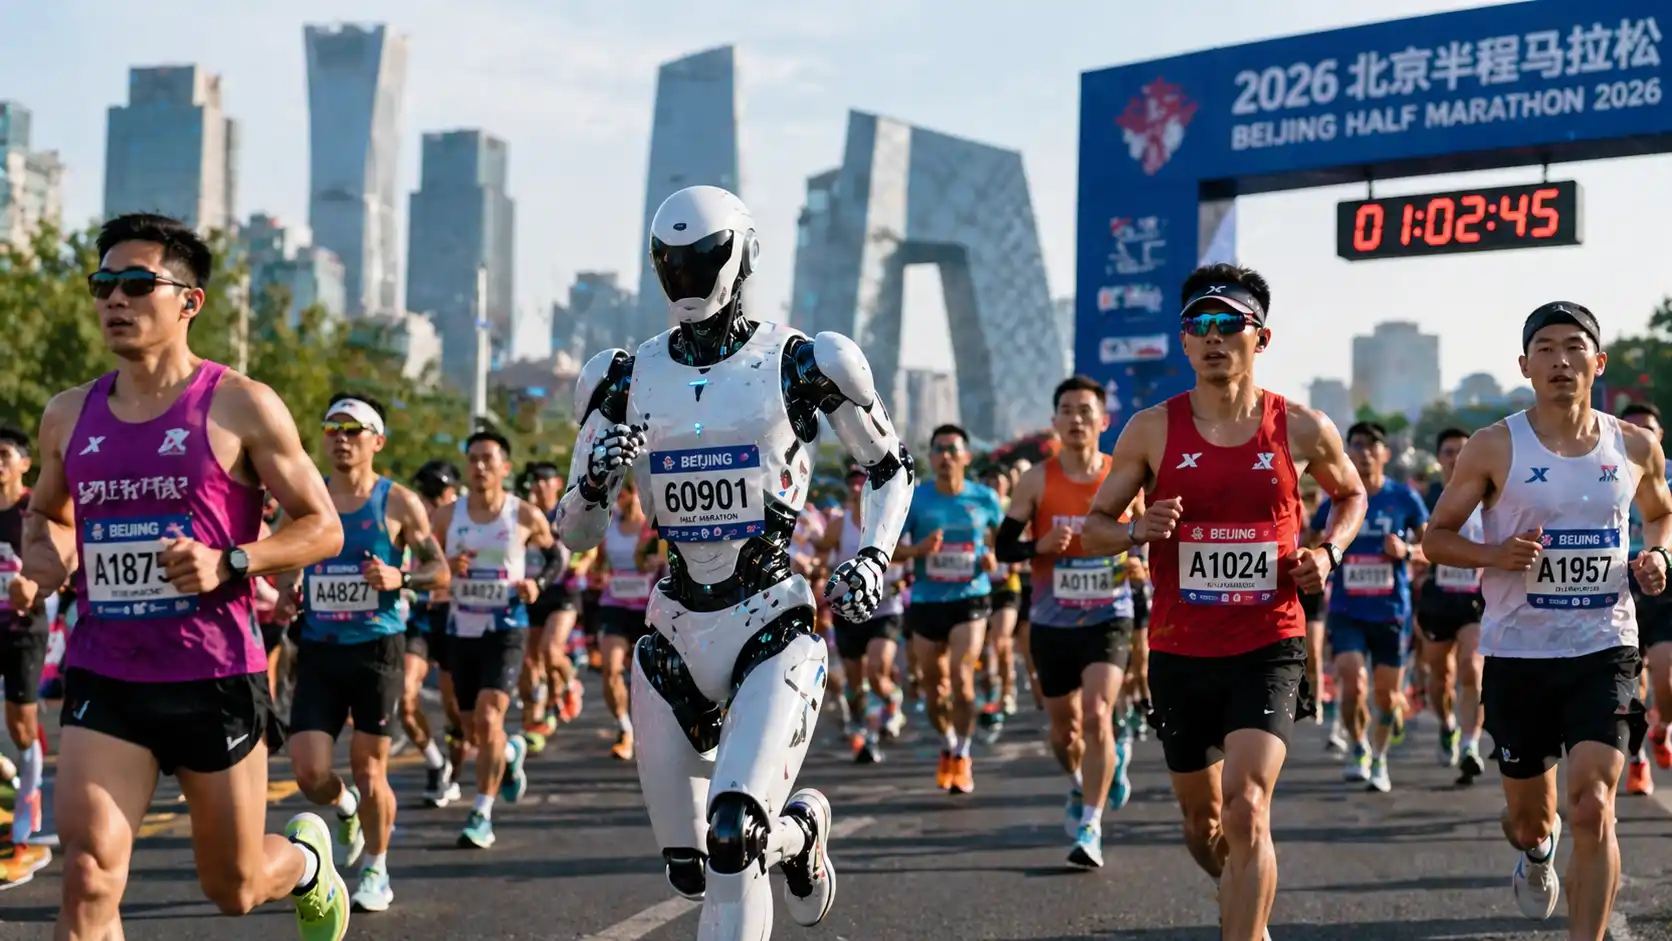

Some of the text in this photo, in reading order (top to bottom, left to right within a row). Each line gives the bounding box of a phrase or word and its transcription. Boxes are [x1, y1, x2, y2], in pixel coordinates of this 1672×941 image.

[1232, 16, 1662, 116] 2026 北京半程马拉松
[1231, 77, 1662, 150] BEIJING HALF MARATHON 2026
[681, 453, 733, 469] BEIJING
[664, 478, 748, 513] 60901
[109, 522, 160, 538] BEIJING
[1210, 528, 1256, 540] BEIJING
[1558, 534, 1601, 546] BEIJING
[1189, 551, 1269, 579] A1024
[1536, 556, 1612, 583] A1957
[316, 581, 370, 603] A4827
